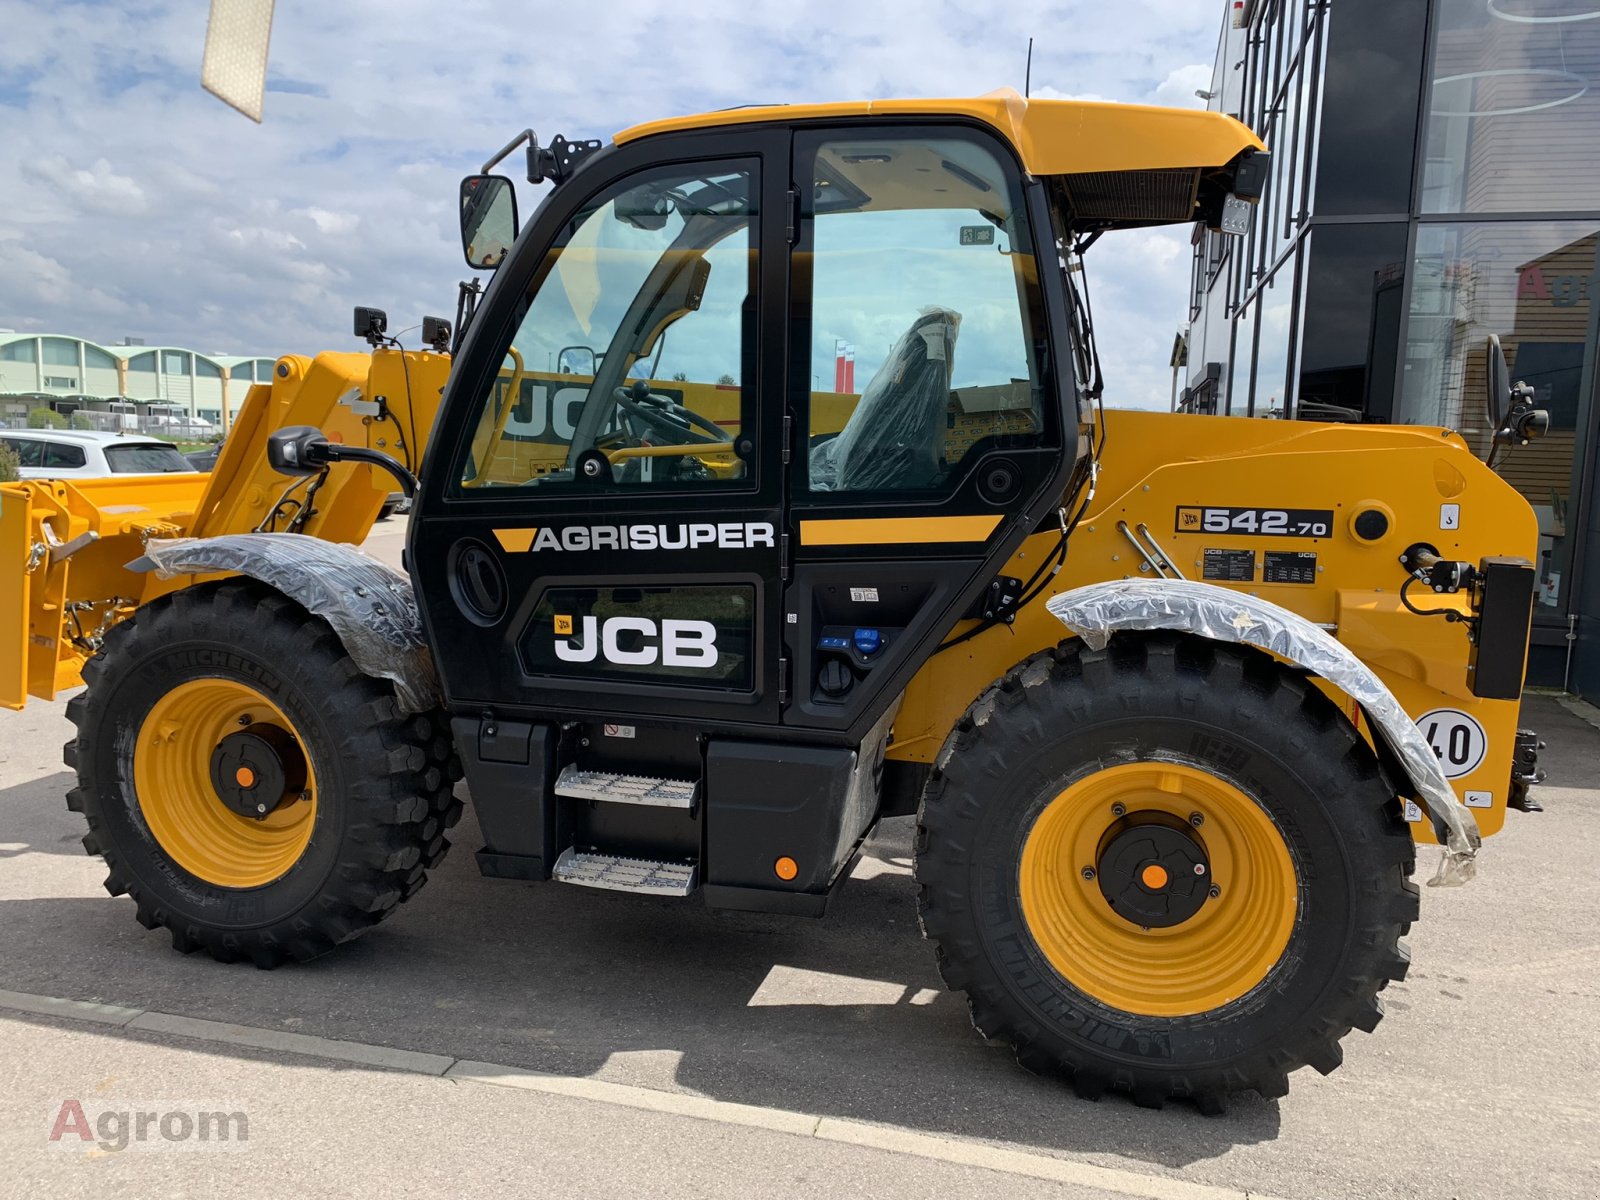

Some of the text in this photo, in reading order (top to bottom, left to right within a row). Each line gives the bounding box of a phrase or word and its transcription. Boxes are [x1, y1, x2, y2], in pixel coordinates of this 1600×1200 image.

[532, 522, 775, 552] AGRISUPER
[1204, 509, 1326, 535] 542-70
[554, 615, 718, 668] JCB
[1426, 722, 1471, 766] 40
